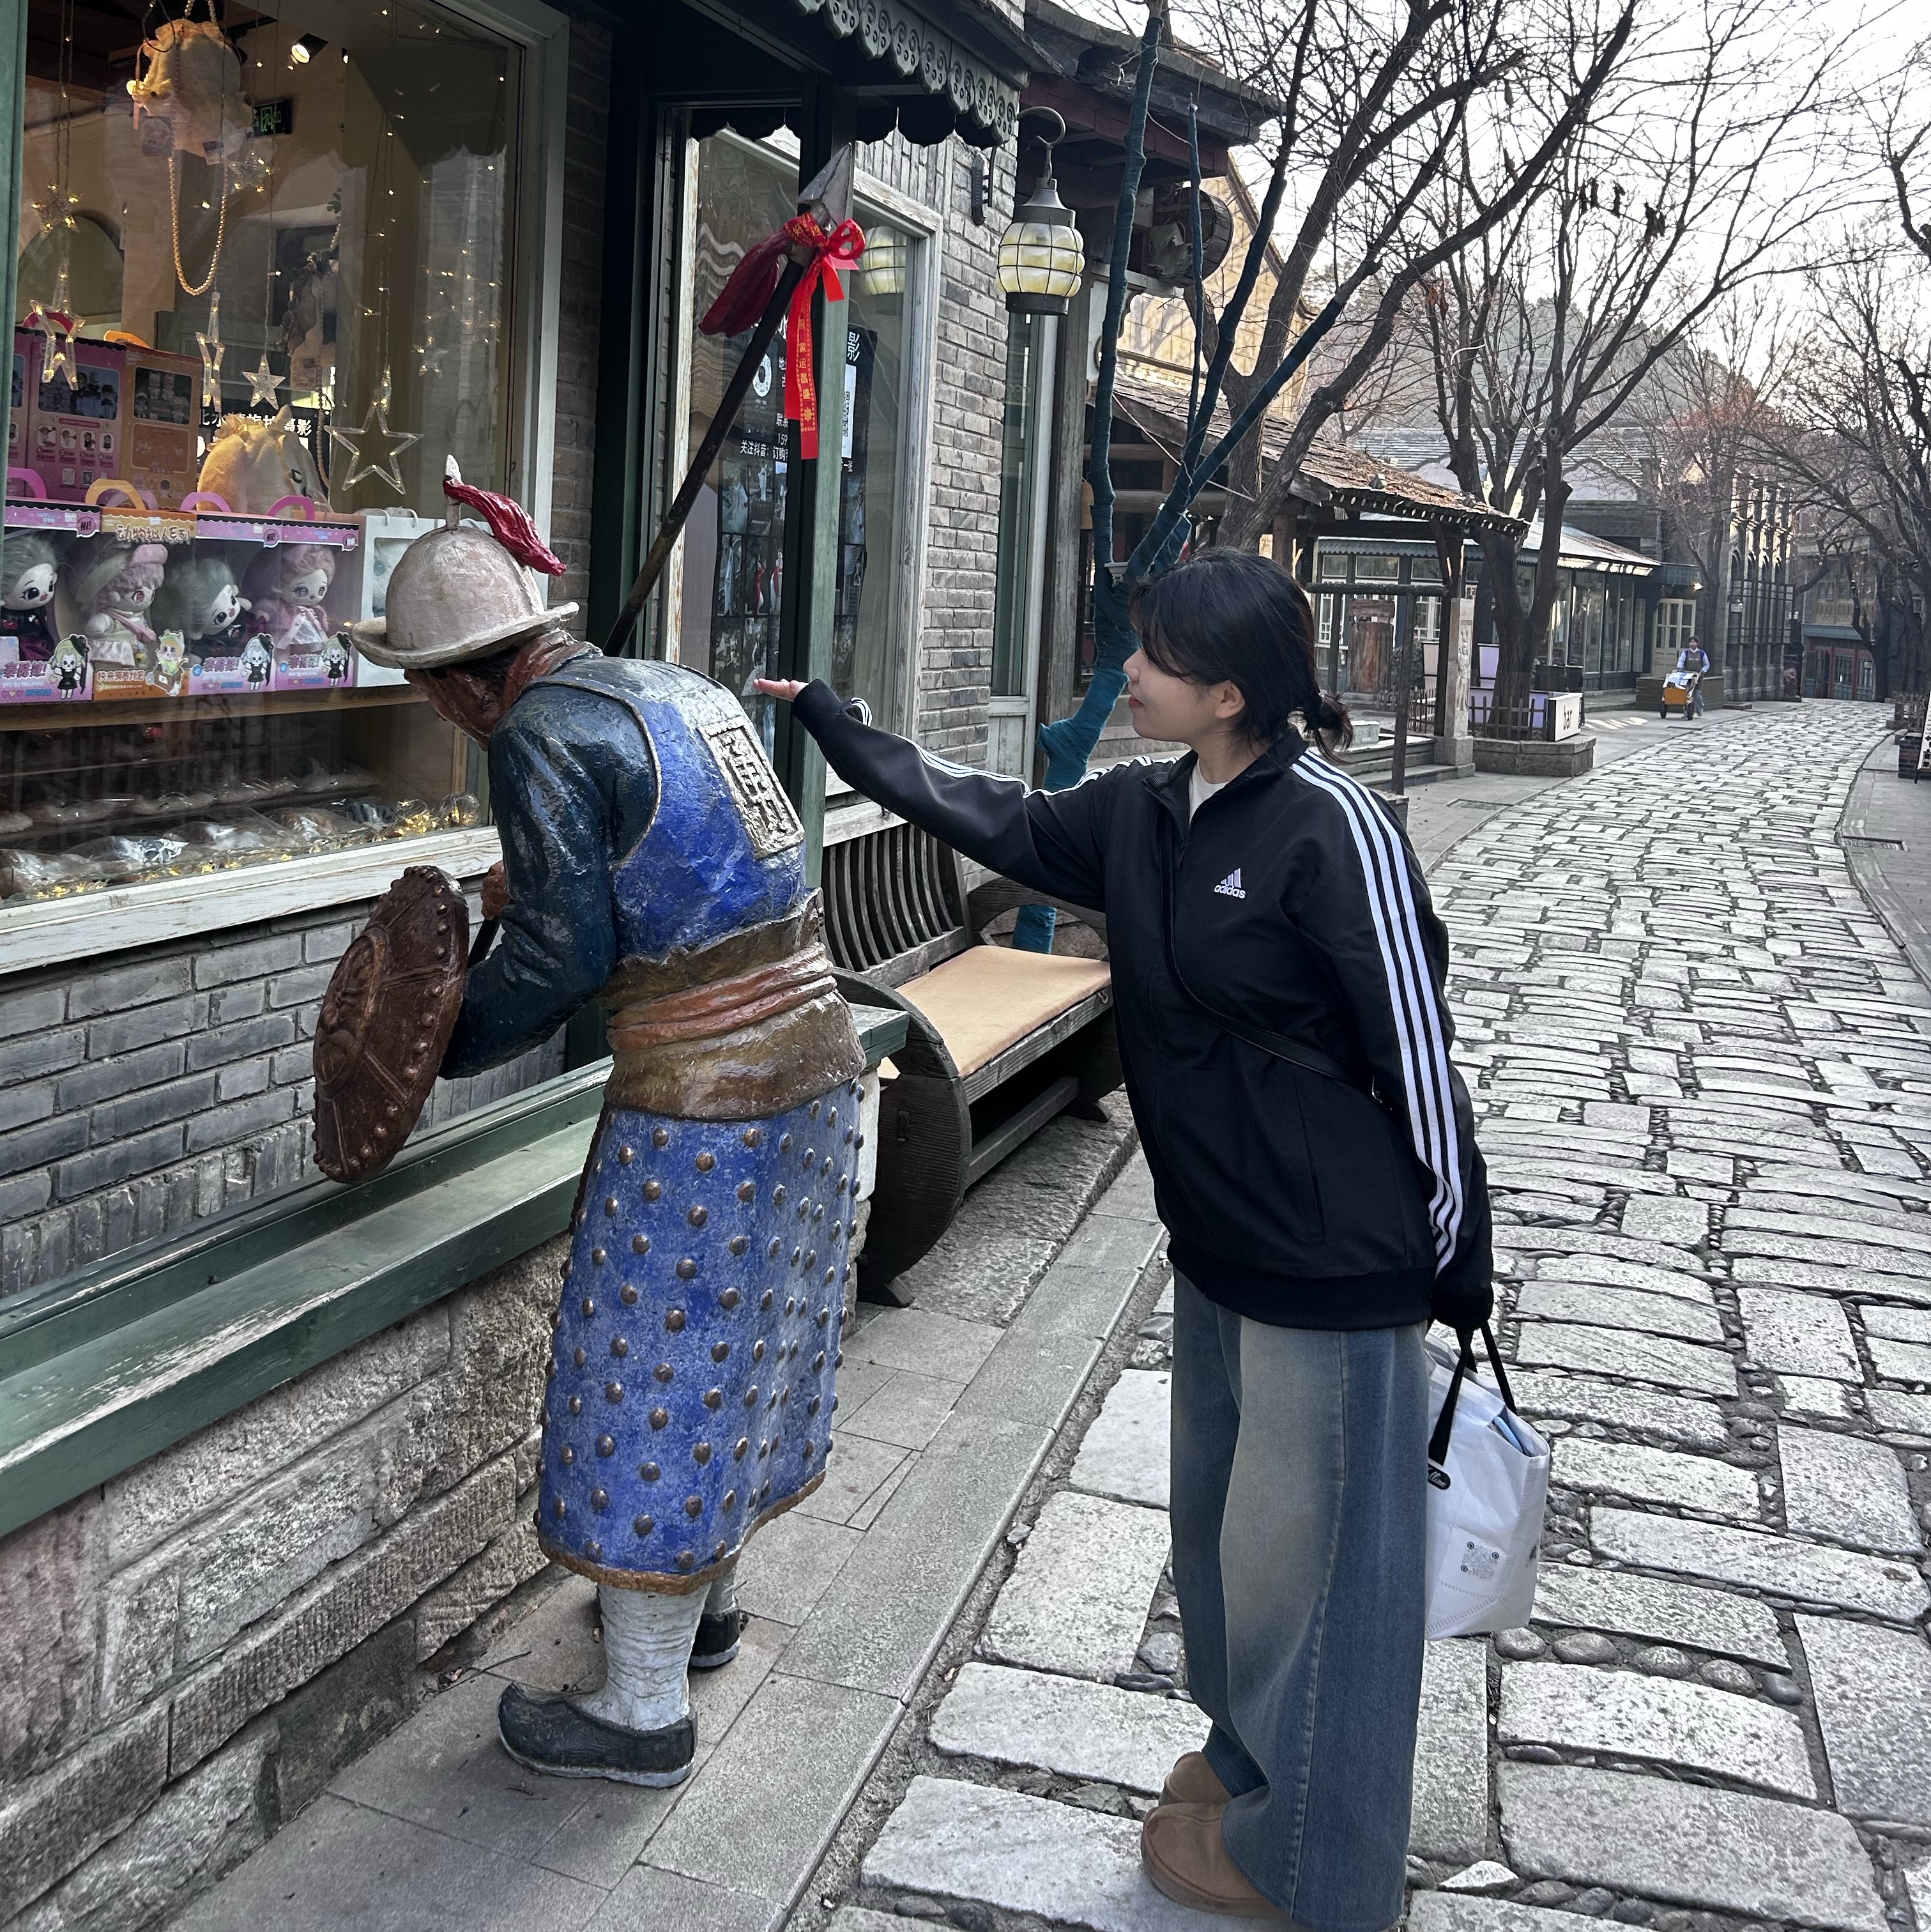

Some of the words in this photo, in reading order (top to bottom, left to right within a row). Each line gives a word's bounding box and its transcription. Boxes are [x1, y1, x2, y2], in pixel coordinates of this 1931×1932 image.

[847, 332, 860, 362] 影
[80, 520, 92, 531] HI!
[1563, 705, 1573, 730] bar
[1214, 884, 1246, 899] adidas
